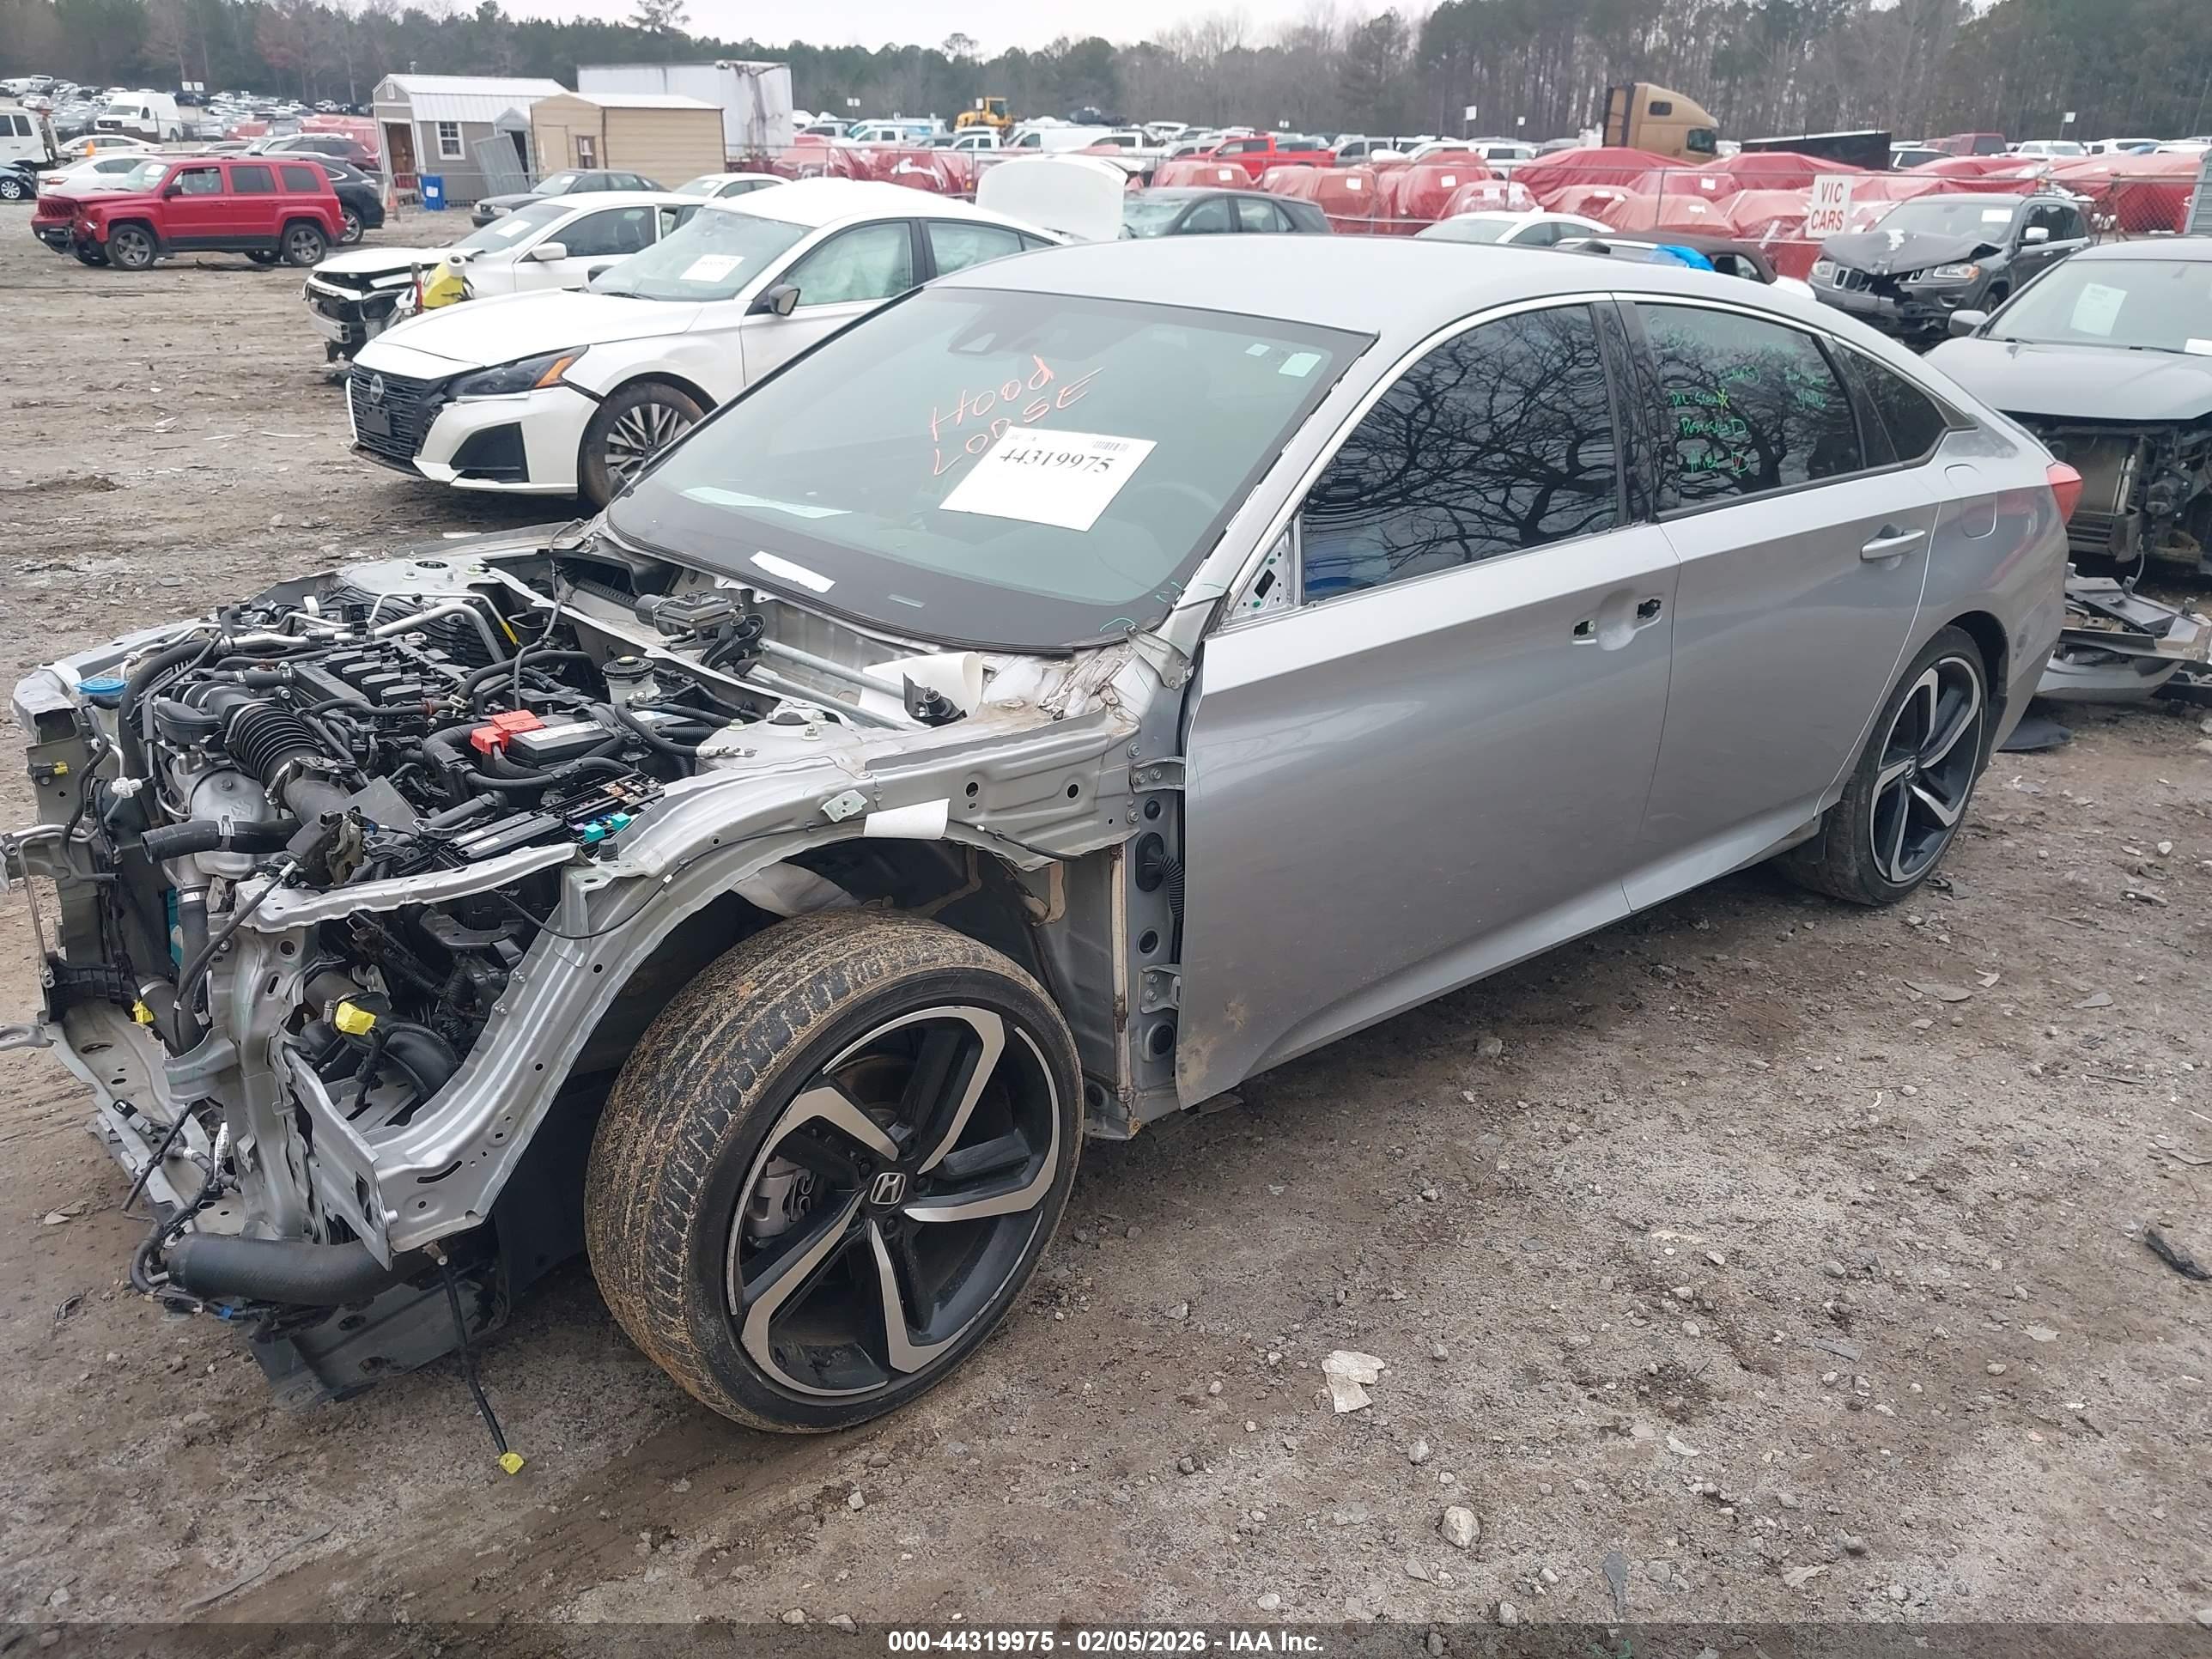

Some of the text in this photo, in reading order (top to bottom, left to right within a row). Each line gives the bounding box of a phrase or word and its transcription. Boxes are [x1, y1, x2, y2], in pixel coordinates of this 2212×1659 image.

[1821, 182, 1844, 204] VIC
[1811, 209, 1844, 231] CARS
[1000, 447, 1115, 473] 44319975
